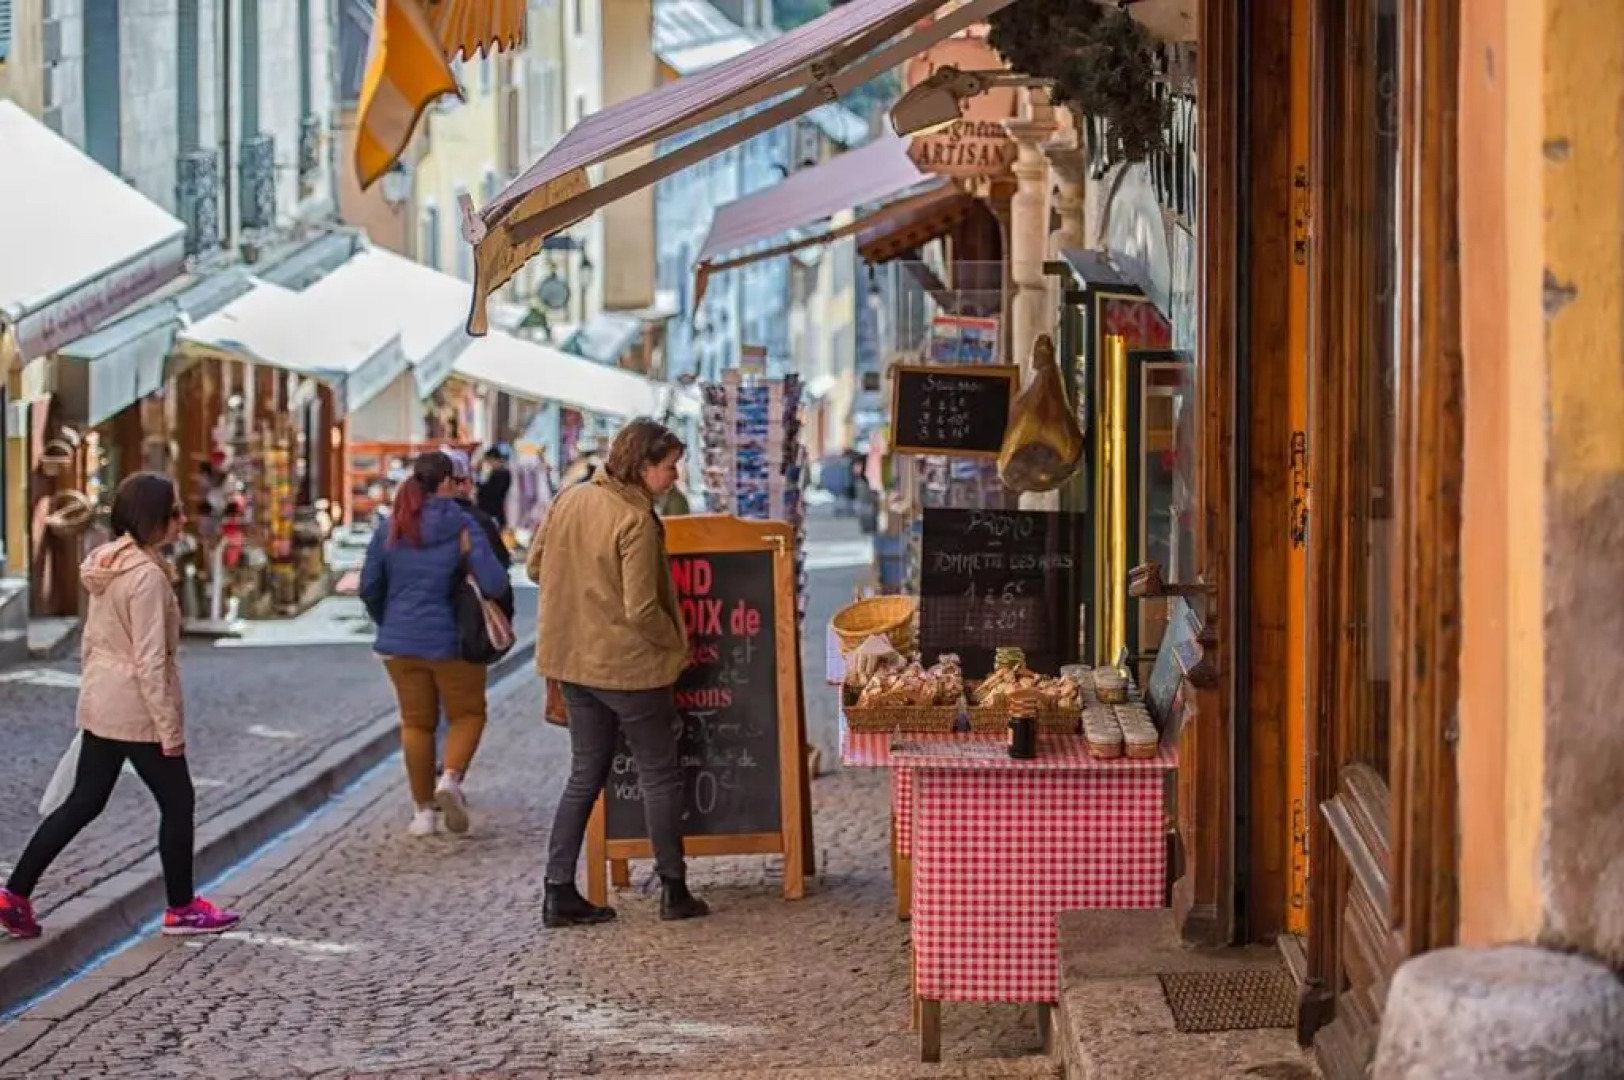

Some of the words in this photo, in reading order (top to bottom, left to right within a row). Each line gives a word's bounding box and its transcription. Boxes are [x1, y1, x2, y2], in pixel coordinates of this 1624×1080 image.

[918, 142, 1006, 166] ARTISAN
[670, 559, 713, 595] ND
[680, 598, 723, 636] OIX
[730, 600, 761, 636] de
[674, 686, 733, 709] ssons
